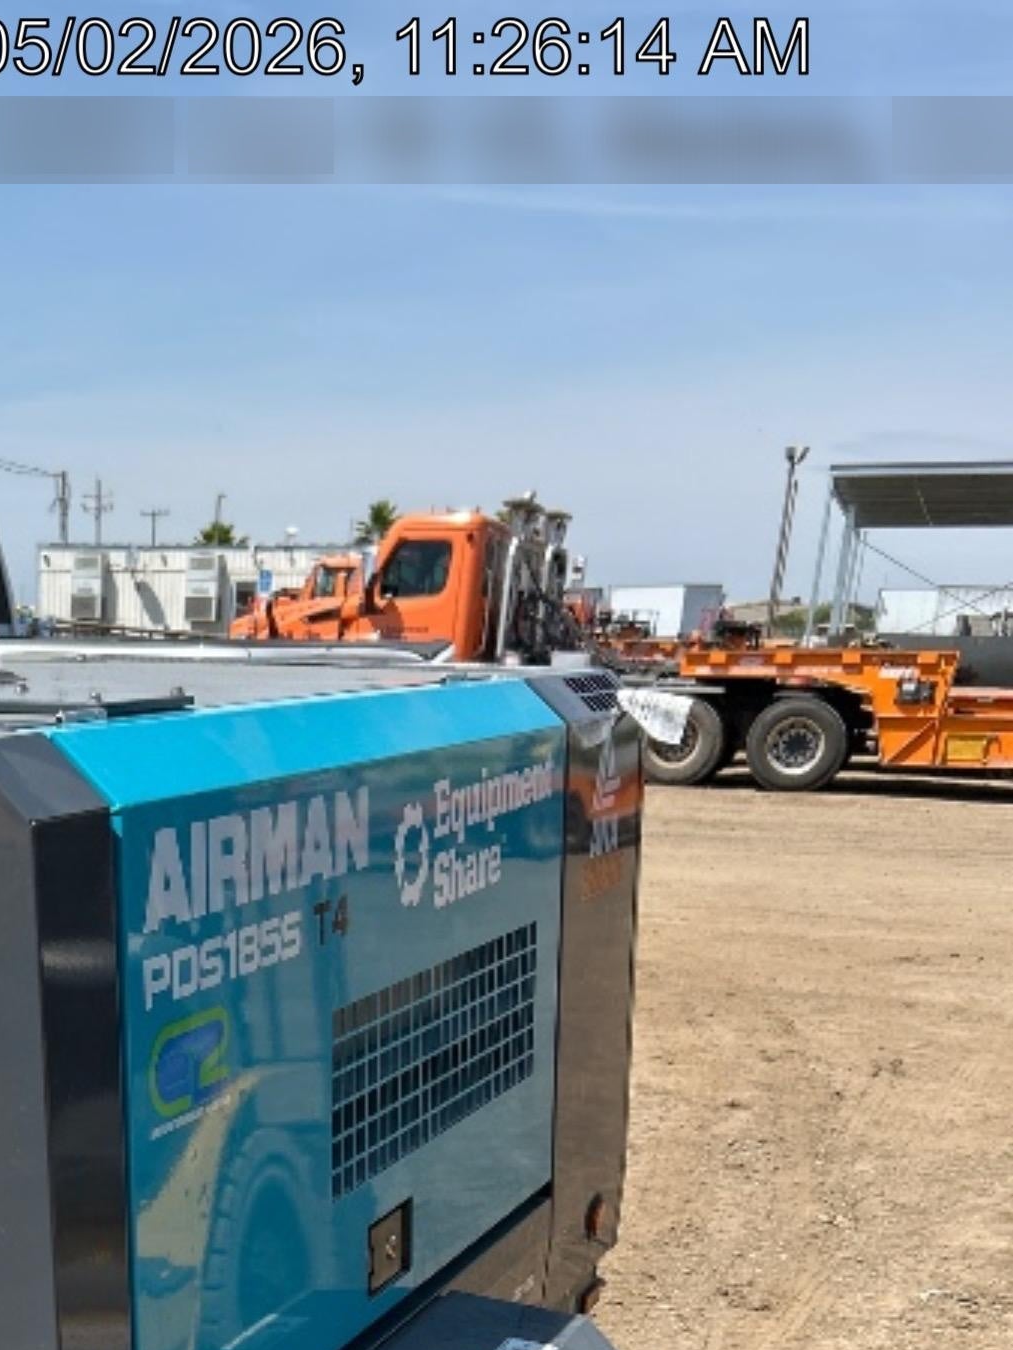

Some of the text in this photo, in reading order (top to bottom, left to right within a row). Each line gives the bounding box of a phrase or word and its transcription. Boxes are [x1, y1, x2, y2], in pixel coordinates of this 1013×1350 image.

[433, 760, 556, 839] Equipment
[144, 786, 370, 934] AIRMAN
[432, 843, 502, 909] Share
[144, 895, 349, 1011] PDS185S T4
